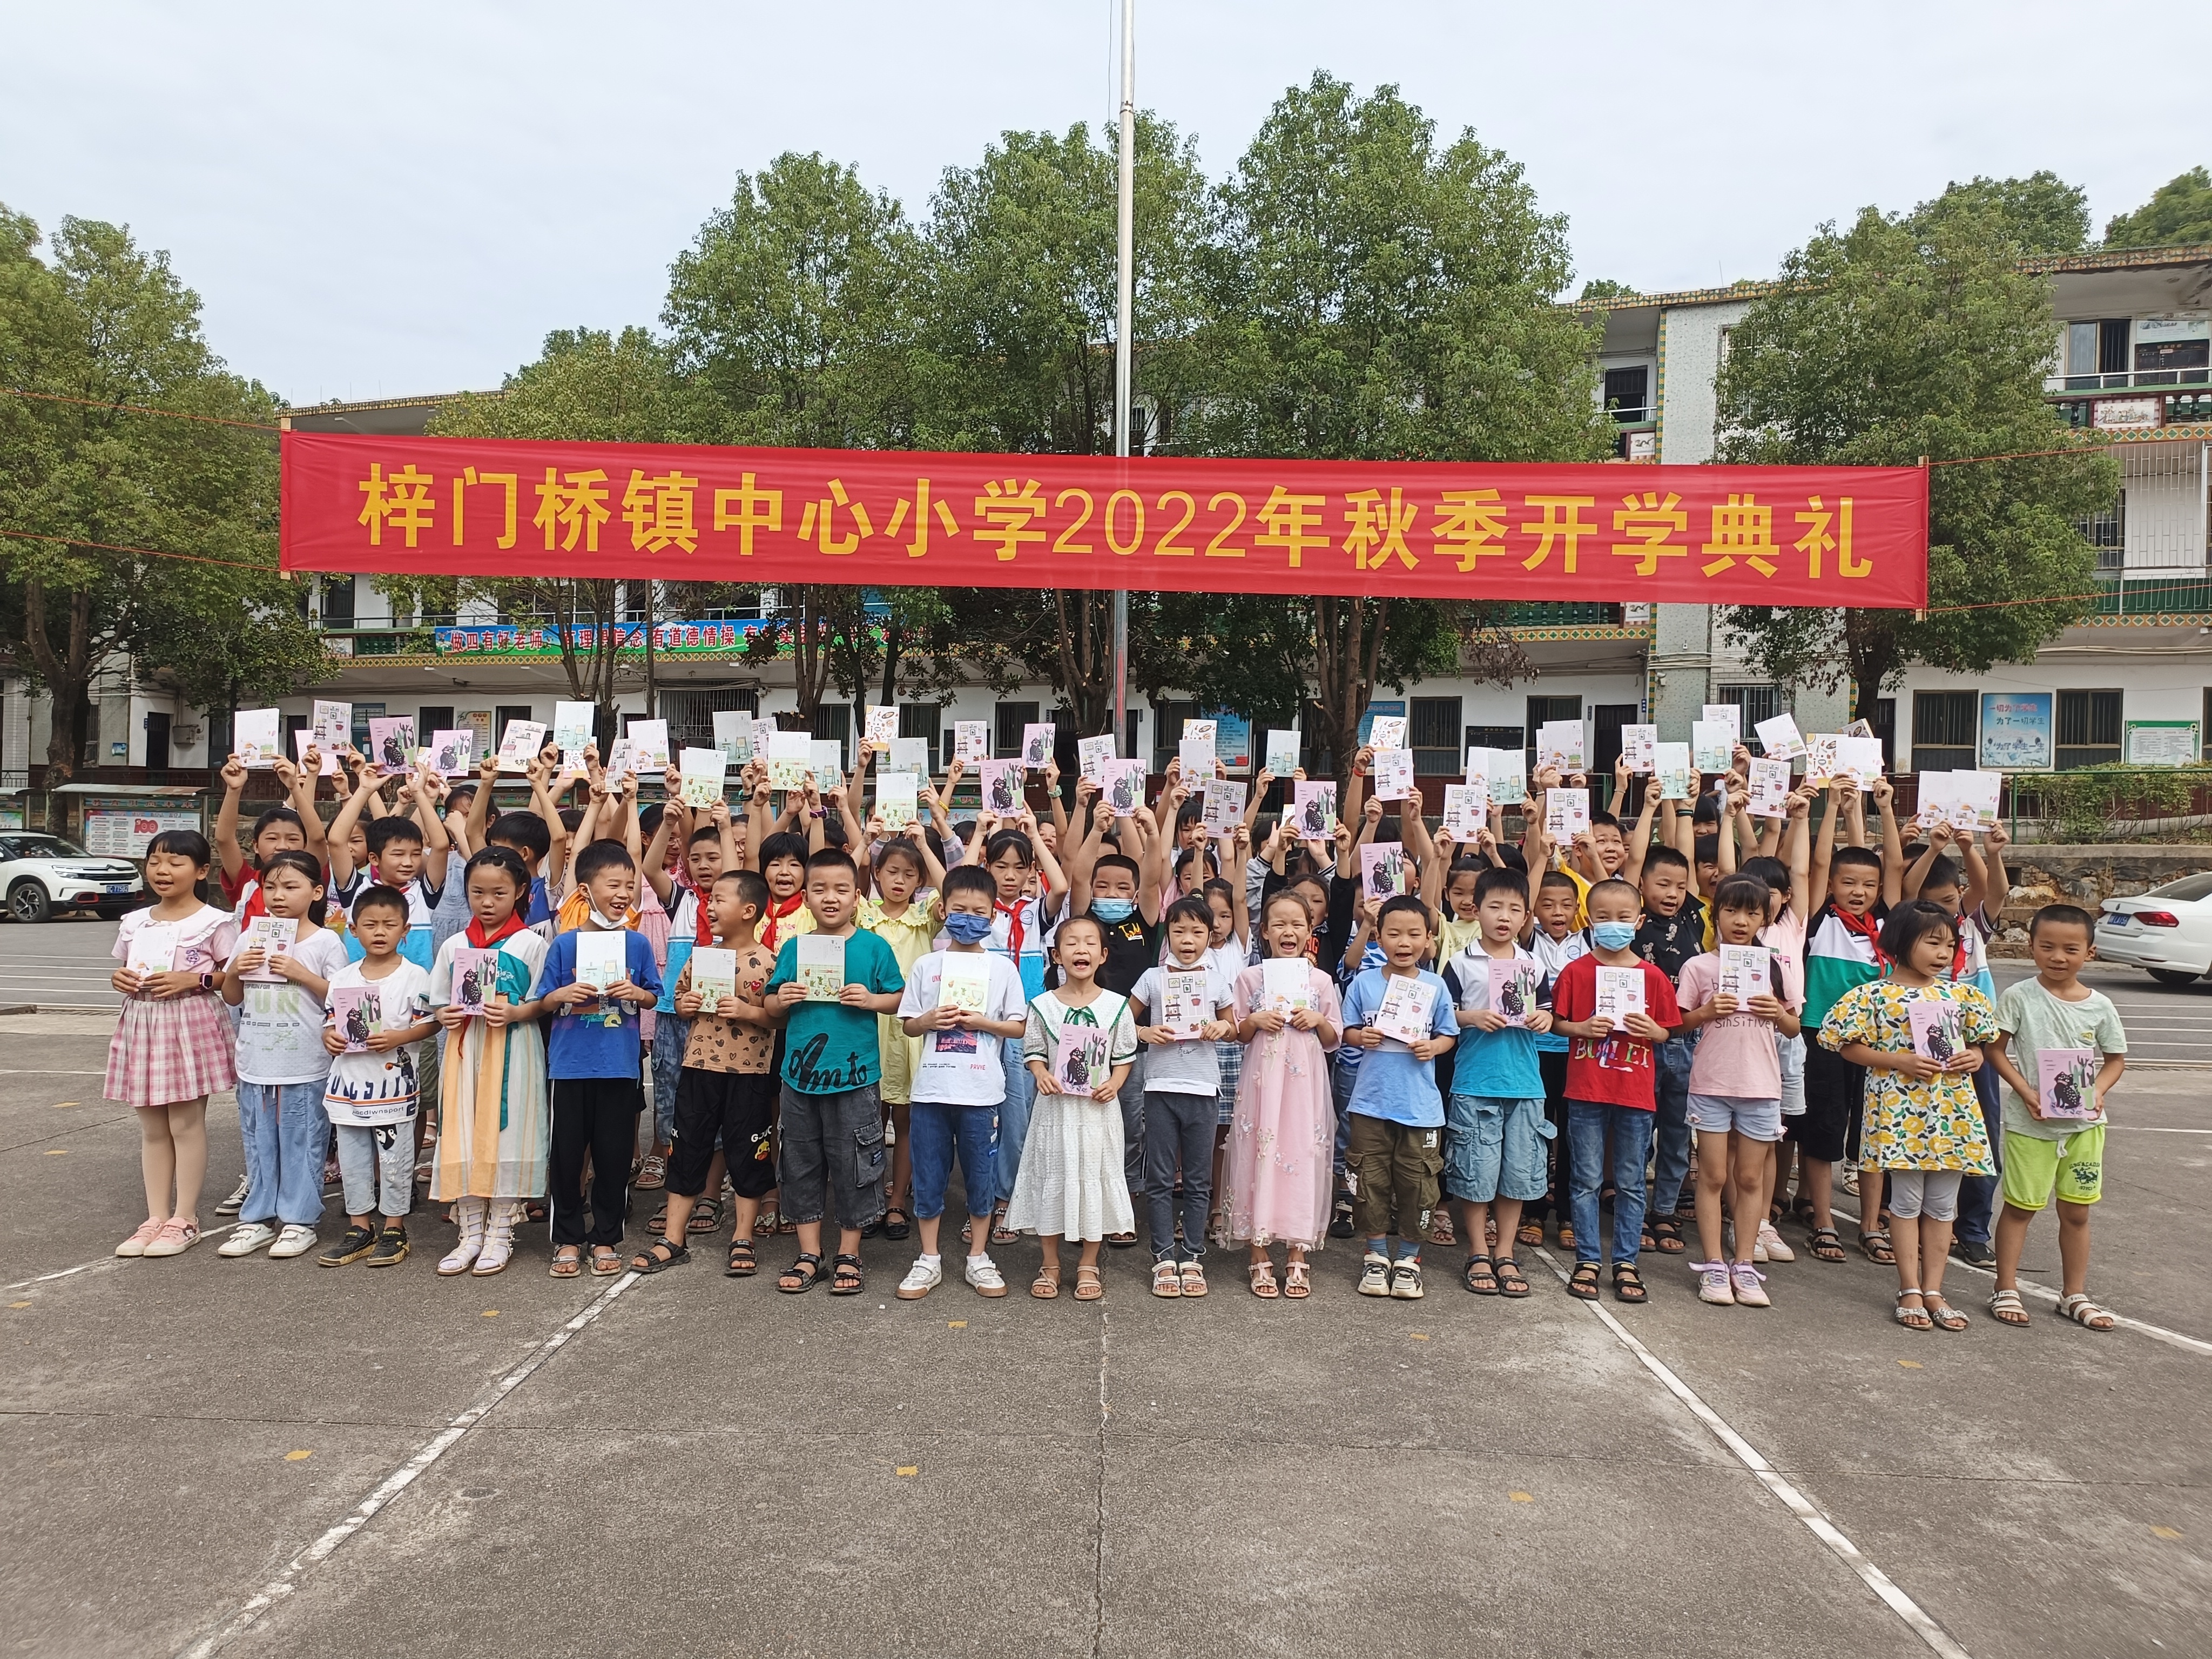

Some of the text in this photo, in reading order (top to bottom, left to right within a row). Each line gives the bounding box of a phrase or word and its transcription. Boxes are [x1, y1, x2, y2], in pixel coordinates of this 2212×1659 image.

[358, 463, 1872, 579] 梓门桥镇中心小学2022年秋季开学典礼
[450, 629, 543, 652] 做四有好老师
[1997, 716, 2045, 725] 为了一切学生
